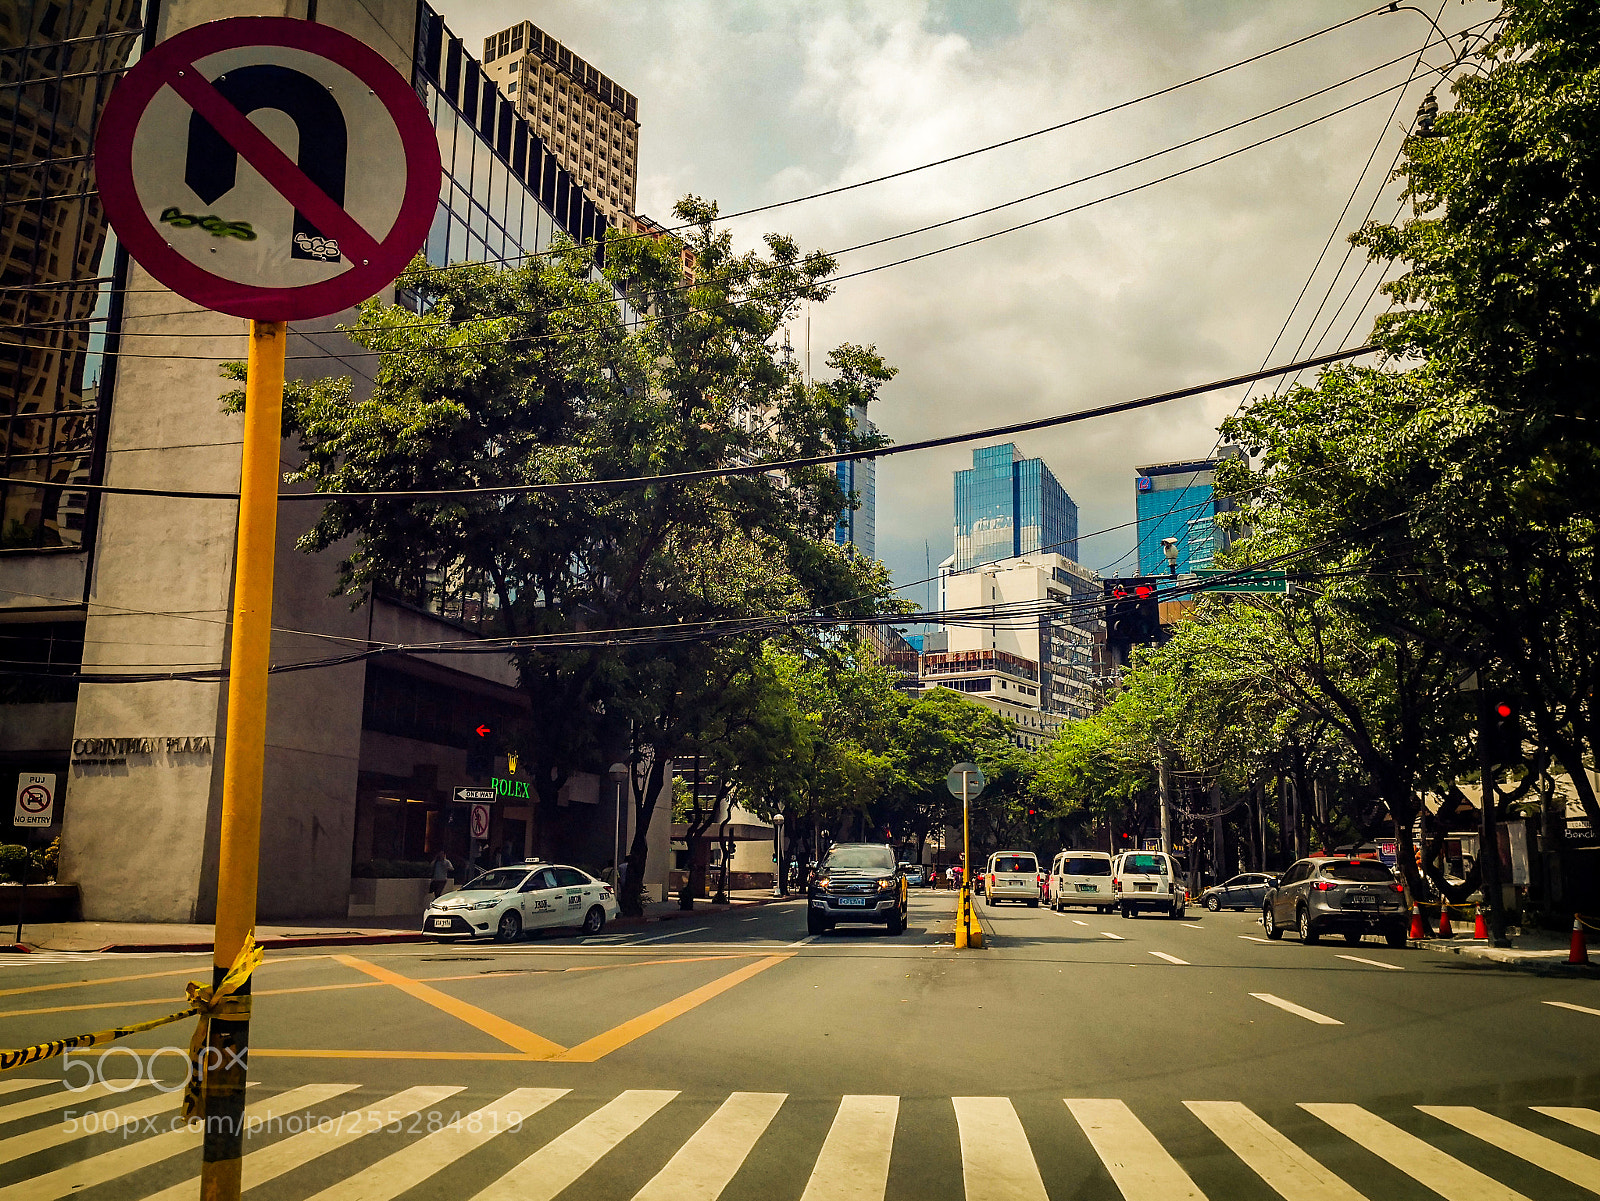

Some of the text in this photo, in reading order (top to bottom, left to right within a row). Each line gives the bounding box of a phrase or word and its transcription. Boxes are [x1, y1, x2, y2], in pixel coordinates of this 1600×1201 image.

[73, 737, 211, 755] CORINTHIAN PLAZA
[491, 777, 530, 799] ROLEX
[27, 816, 51, 824] ENTRY
